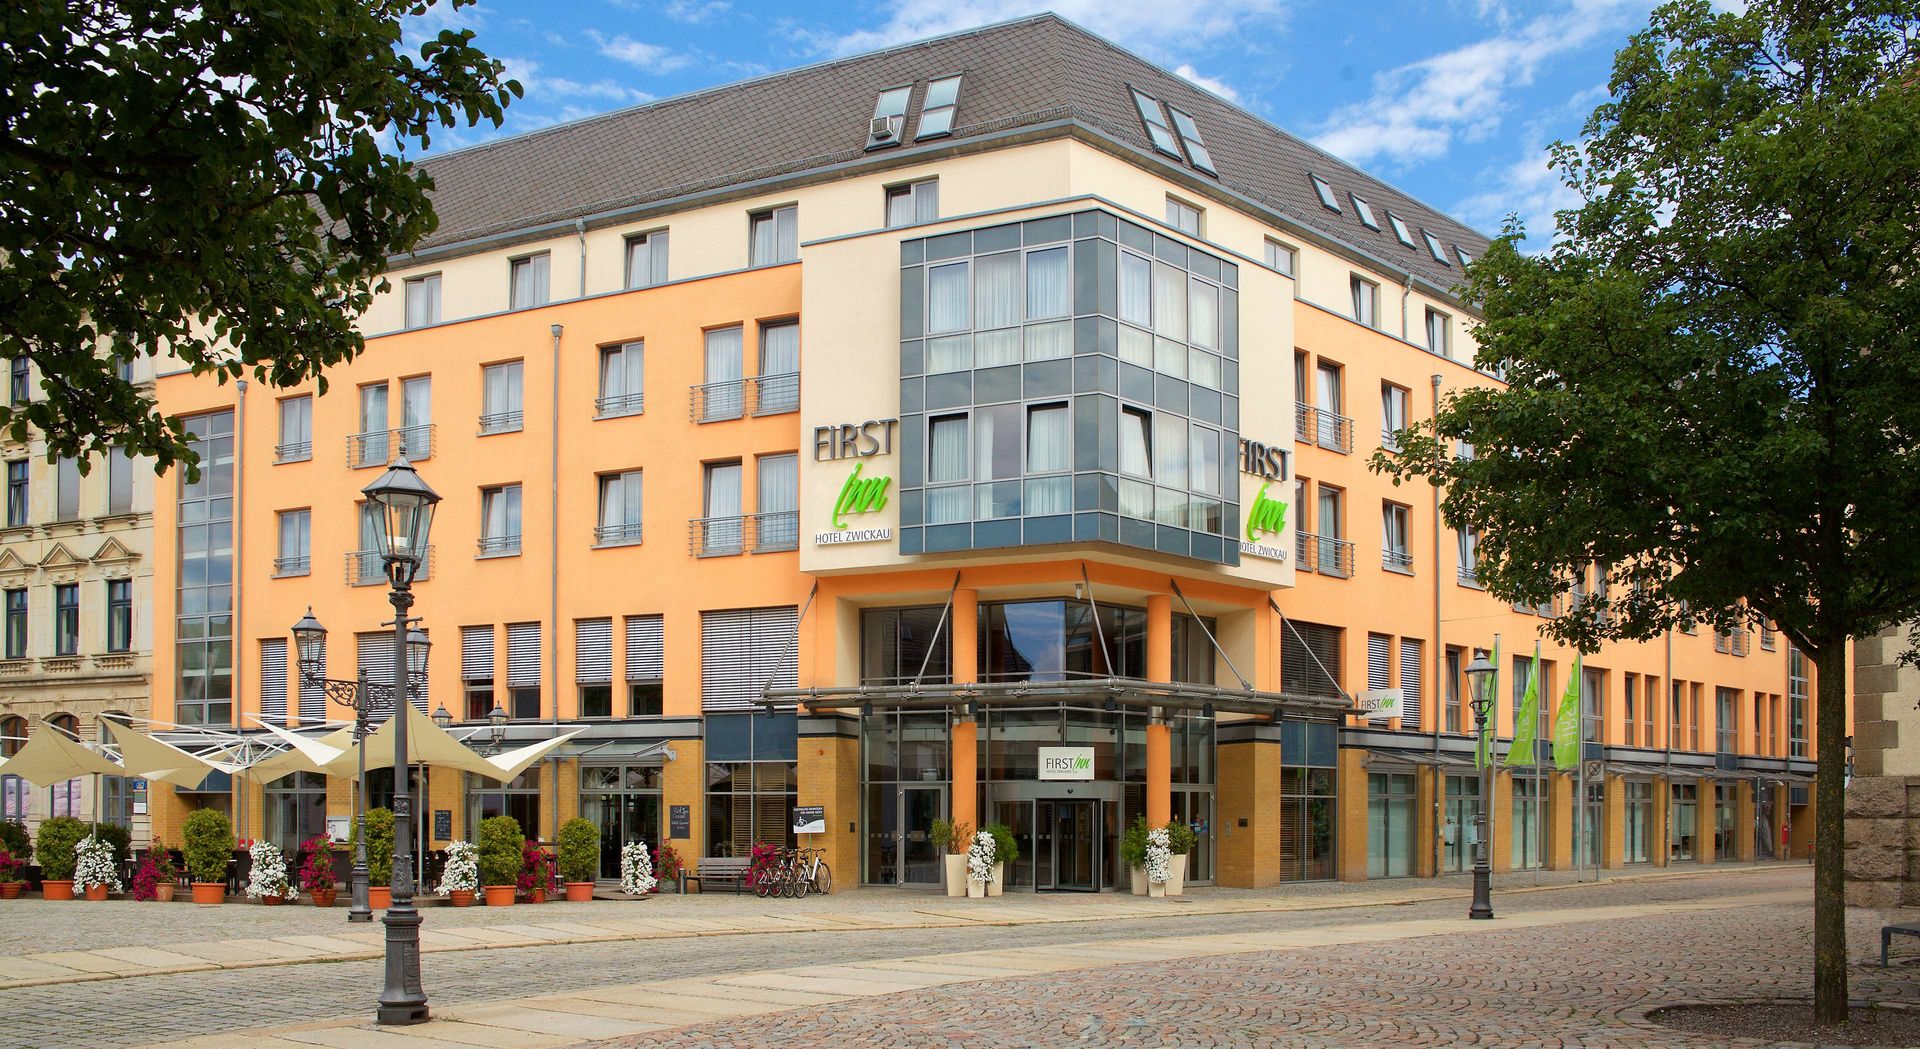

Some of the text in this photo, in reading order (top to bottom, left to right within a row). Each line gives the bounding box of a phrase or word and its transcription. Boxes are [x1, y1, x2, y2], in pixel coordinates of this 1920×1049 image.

[814, 418, 898, 462] FIRST
[815, 528, 891, 544] HOTEL ZWICKAU
[1240, 541, 1288, 560] OTEL ZWICKAU
[1361, 699, 1381, 710] FIRST
[1046, 757, 1074, 769] FIRST
